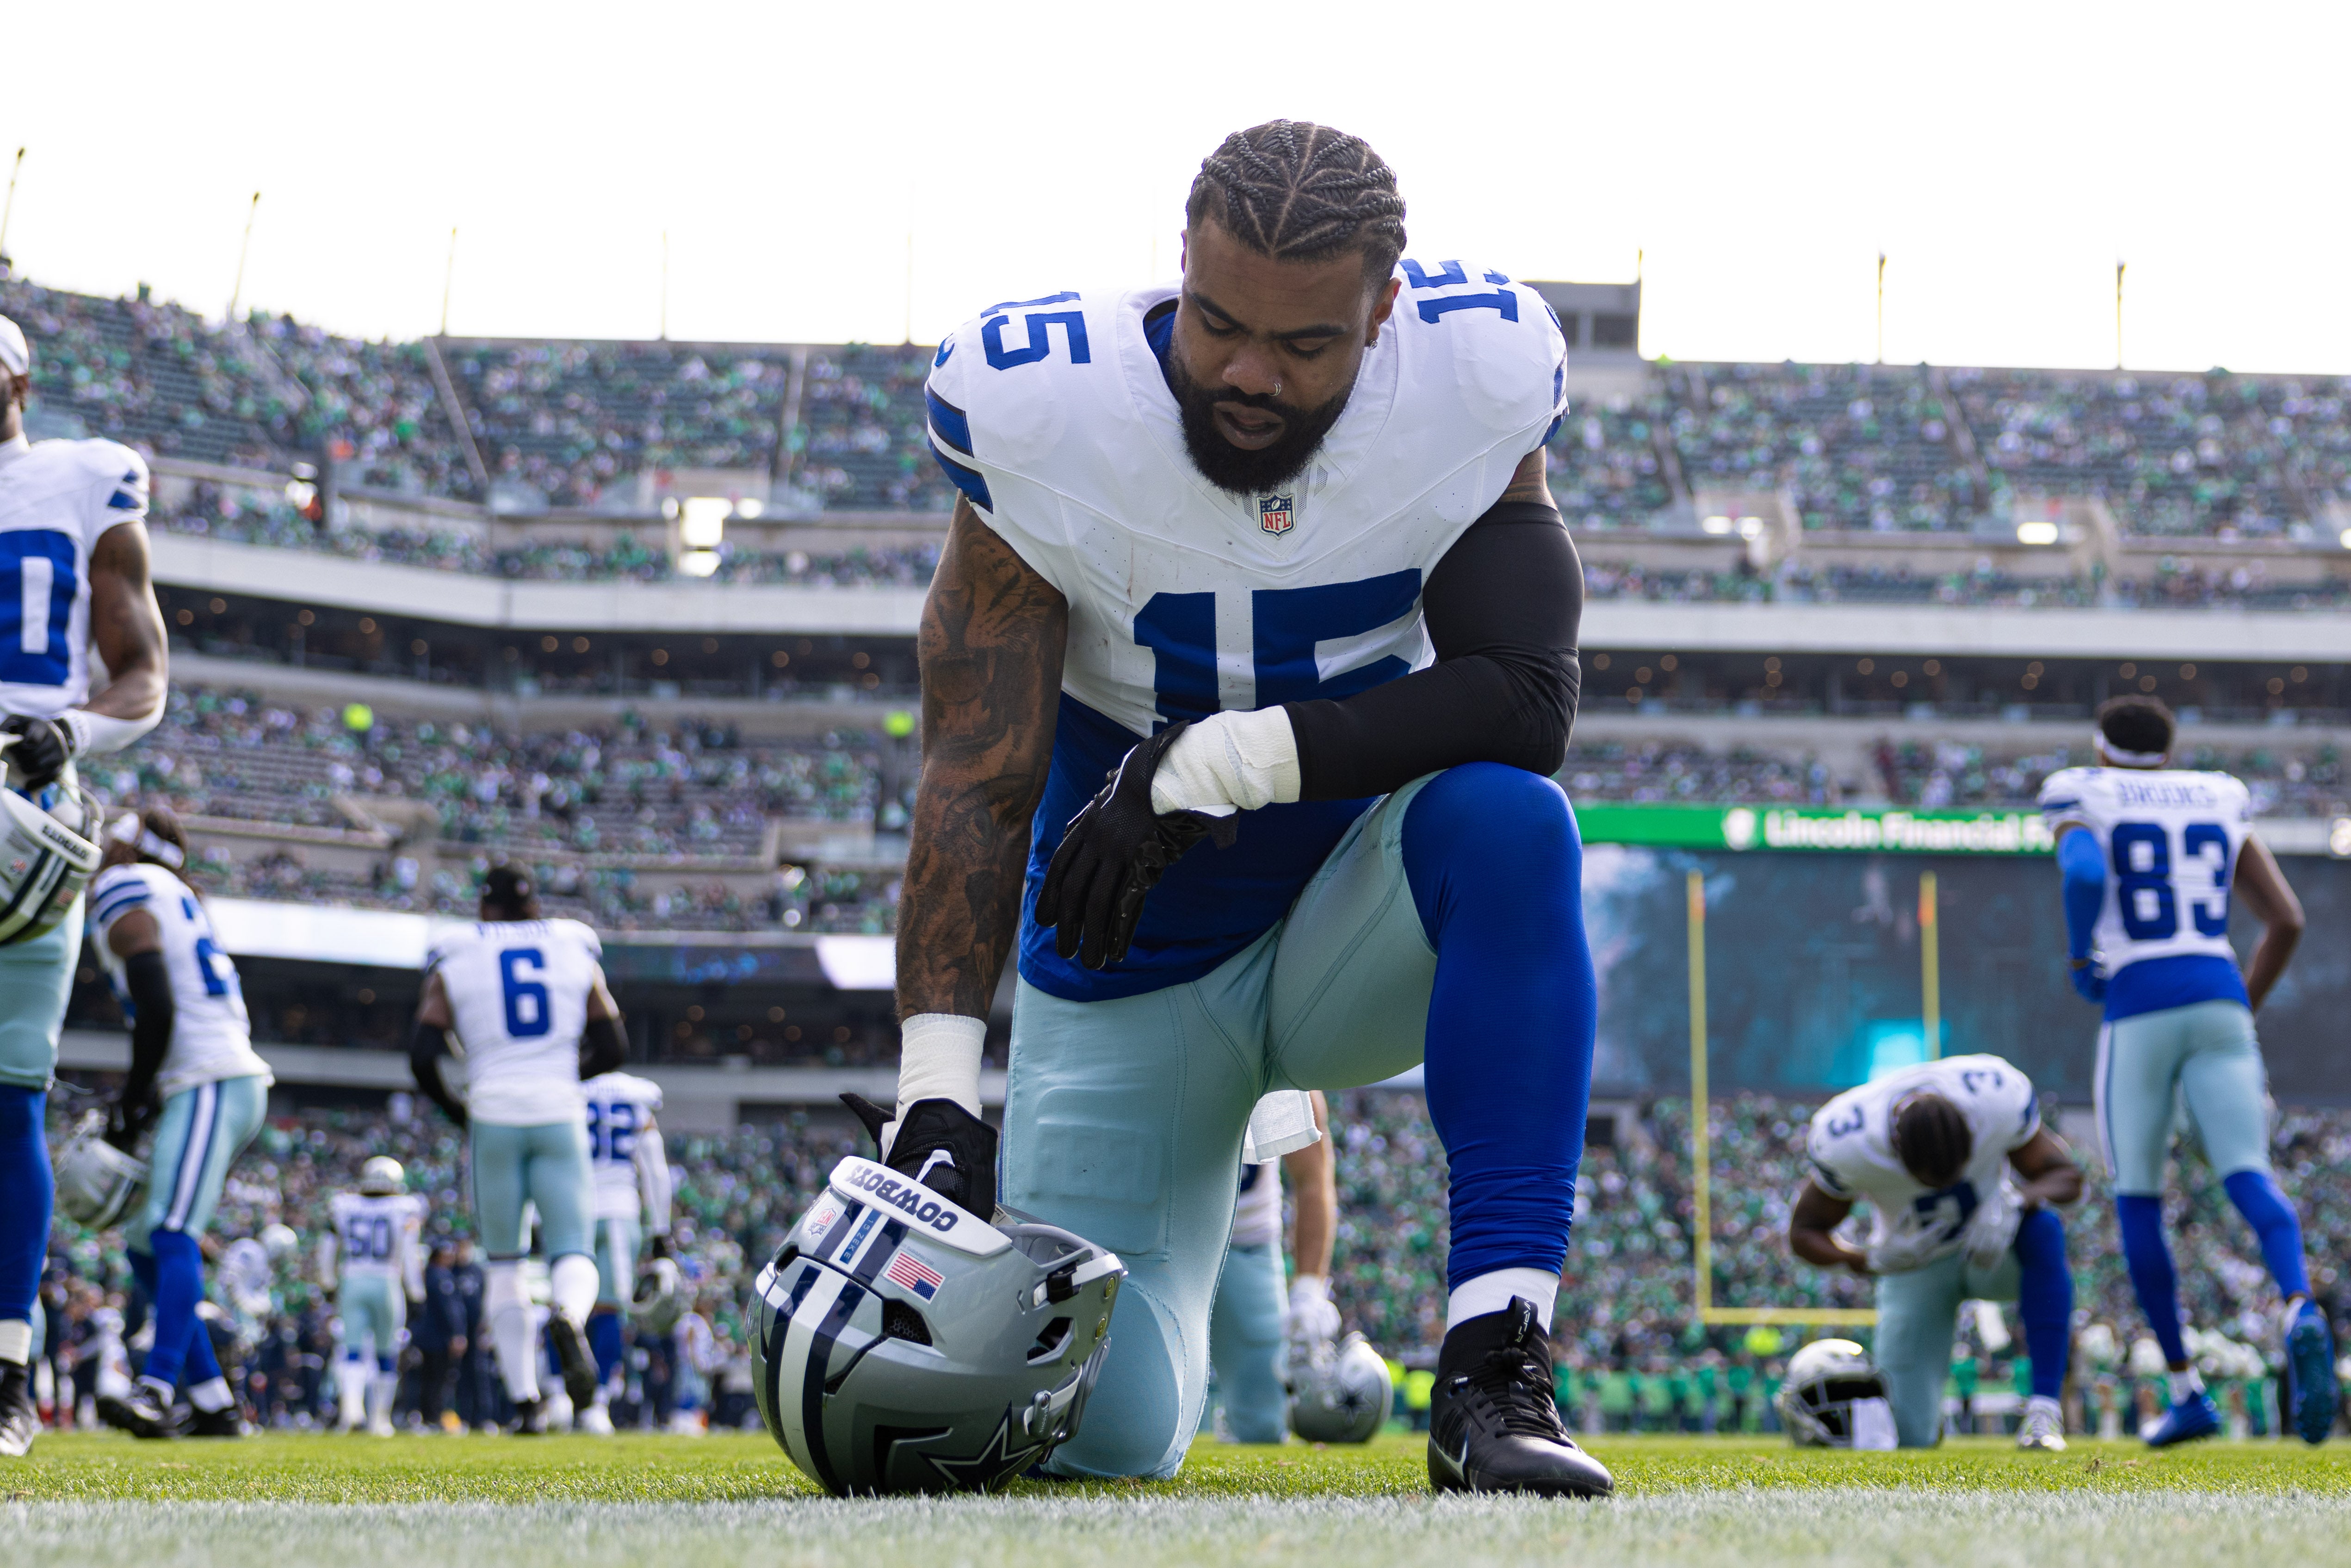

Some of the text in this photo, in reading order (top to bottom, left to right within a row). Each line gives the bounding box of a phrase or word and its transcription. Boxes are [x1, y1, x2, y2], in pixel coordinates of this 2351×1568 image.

[980, 291, 1091, 371] 15
[1263, 511, 1291, 531] NFL
[1134, 568, 1422, 736] 15
[1765, 809, 1880, 849] Lincoln
[1881, 811, 2020, 852] Financial
[2112, 821, 2230, 939] 83
[500, 948, 551, 1037] 6
[843, 1164, 959, 1232] COWBOYS
[349, 1215, 392, 1261] 50
[843, 1219, 874, 1259] 15 ZEKE
